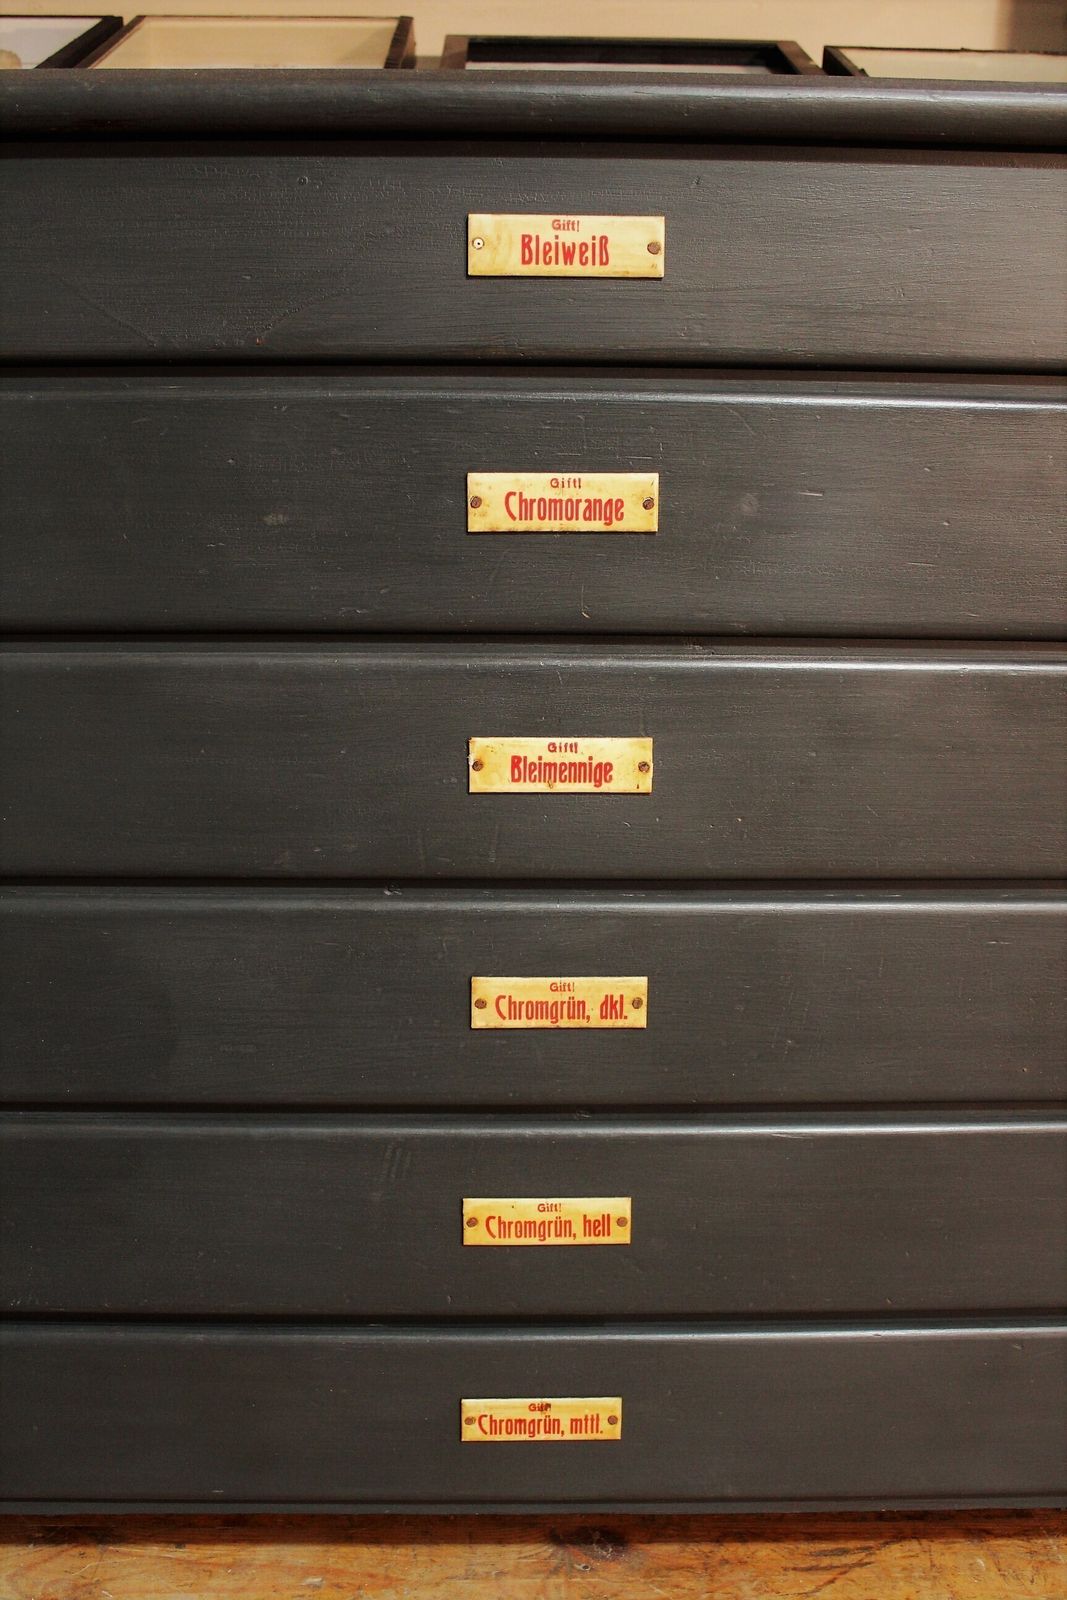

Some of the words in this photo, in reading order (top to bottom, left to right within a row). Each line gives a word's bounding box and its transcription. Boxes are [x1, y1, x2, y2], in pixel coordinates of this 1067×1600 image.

[551, 219, 580, 232] Gift!
[520, 234, 609, 266] Bleiweiß
[550, 478, 581, 489] Gift!
[504, 491, 624, 526] Chromorange
[547, 742, 578, 753] Gift!
[511, 755, 613, 788] Bleimennige
[550, 982, 575, 993] Gift!
[495, 995, 591, 1024] Chromgrün,
[599, 994, 628, 1020] dkl.
[537, 1203, 562, 1213] Gift!
[485, 1215, 576, 1241] Chromgrün,
[583, 1213, 611, 1237] hell
[477, 1414, 565, 1438] Chromgrün,
[570, 1413, 603, 1434] mttl.
